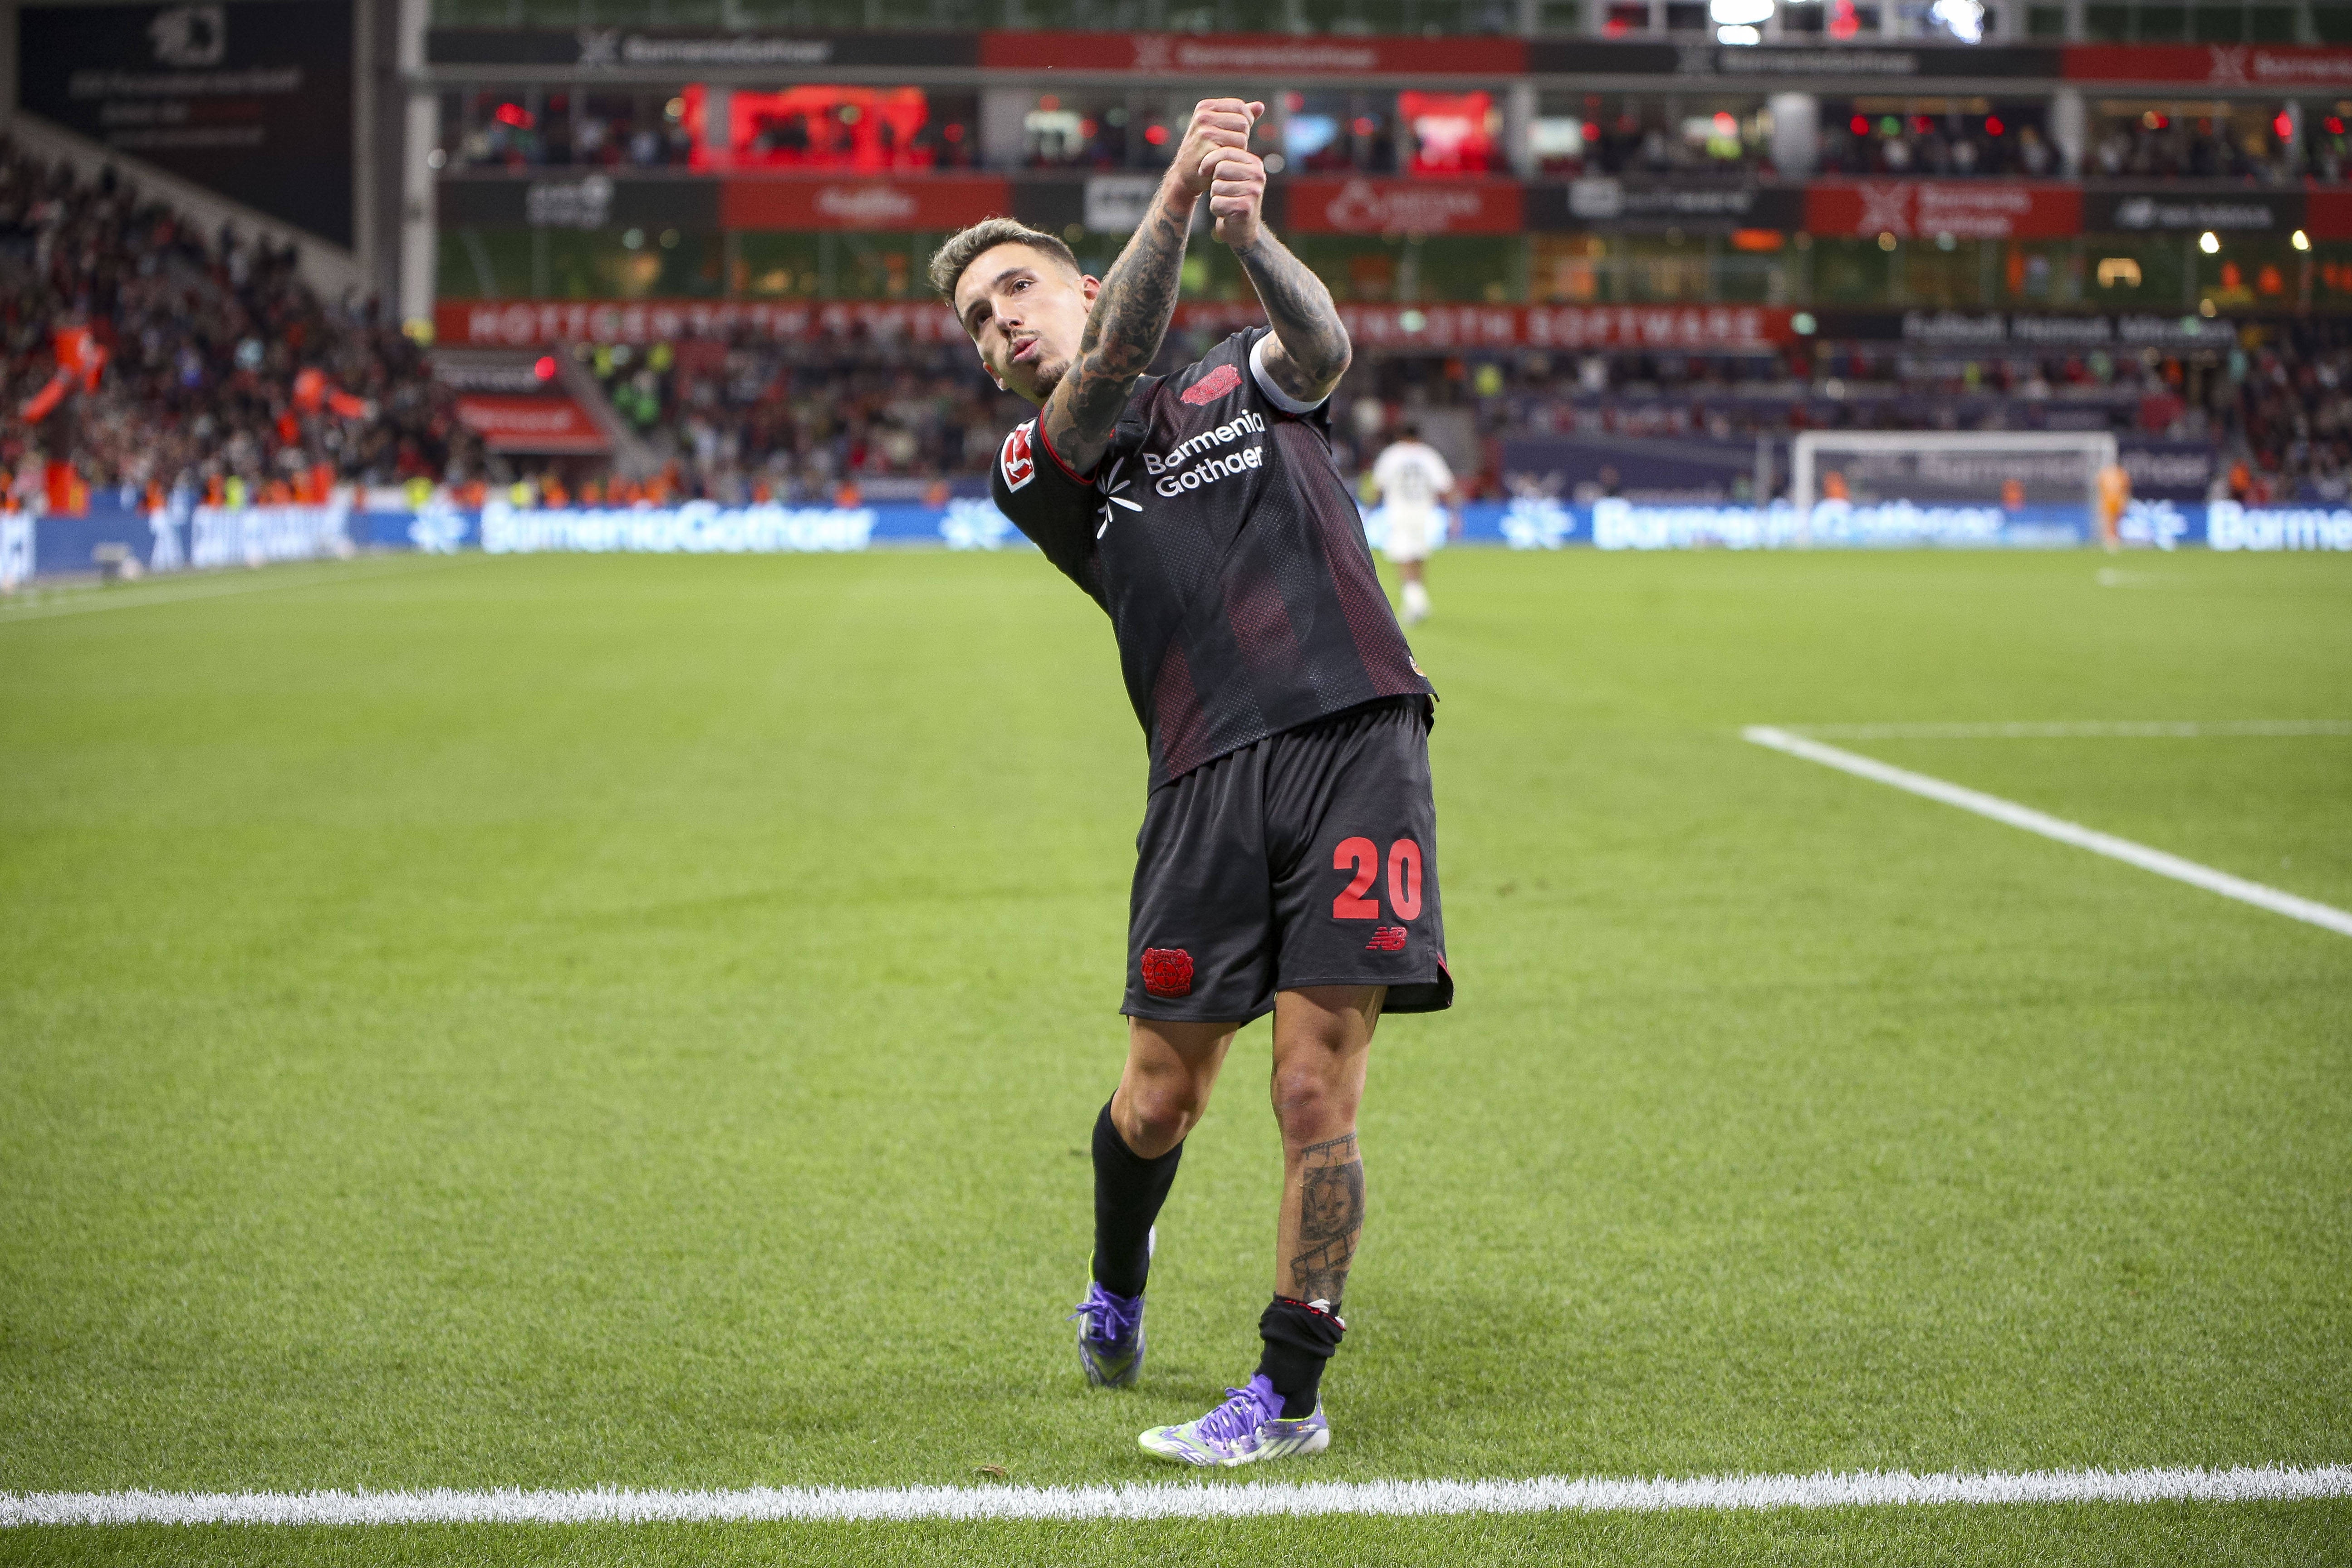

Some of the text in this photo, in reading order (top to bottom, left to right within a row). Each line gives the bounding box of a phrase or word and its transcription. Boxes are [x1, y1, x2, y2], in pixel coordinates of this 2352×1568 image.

[1143, 409, 1265, 475] Barmenia
[1156, 446, 1263, 497] Gothaer
[481, 501, 877, 554] BarmeniaGothaer
[1592, 496, 2006, 550] BarmeniGothaer
[1333, 837, 1421, 921] 20
